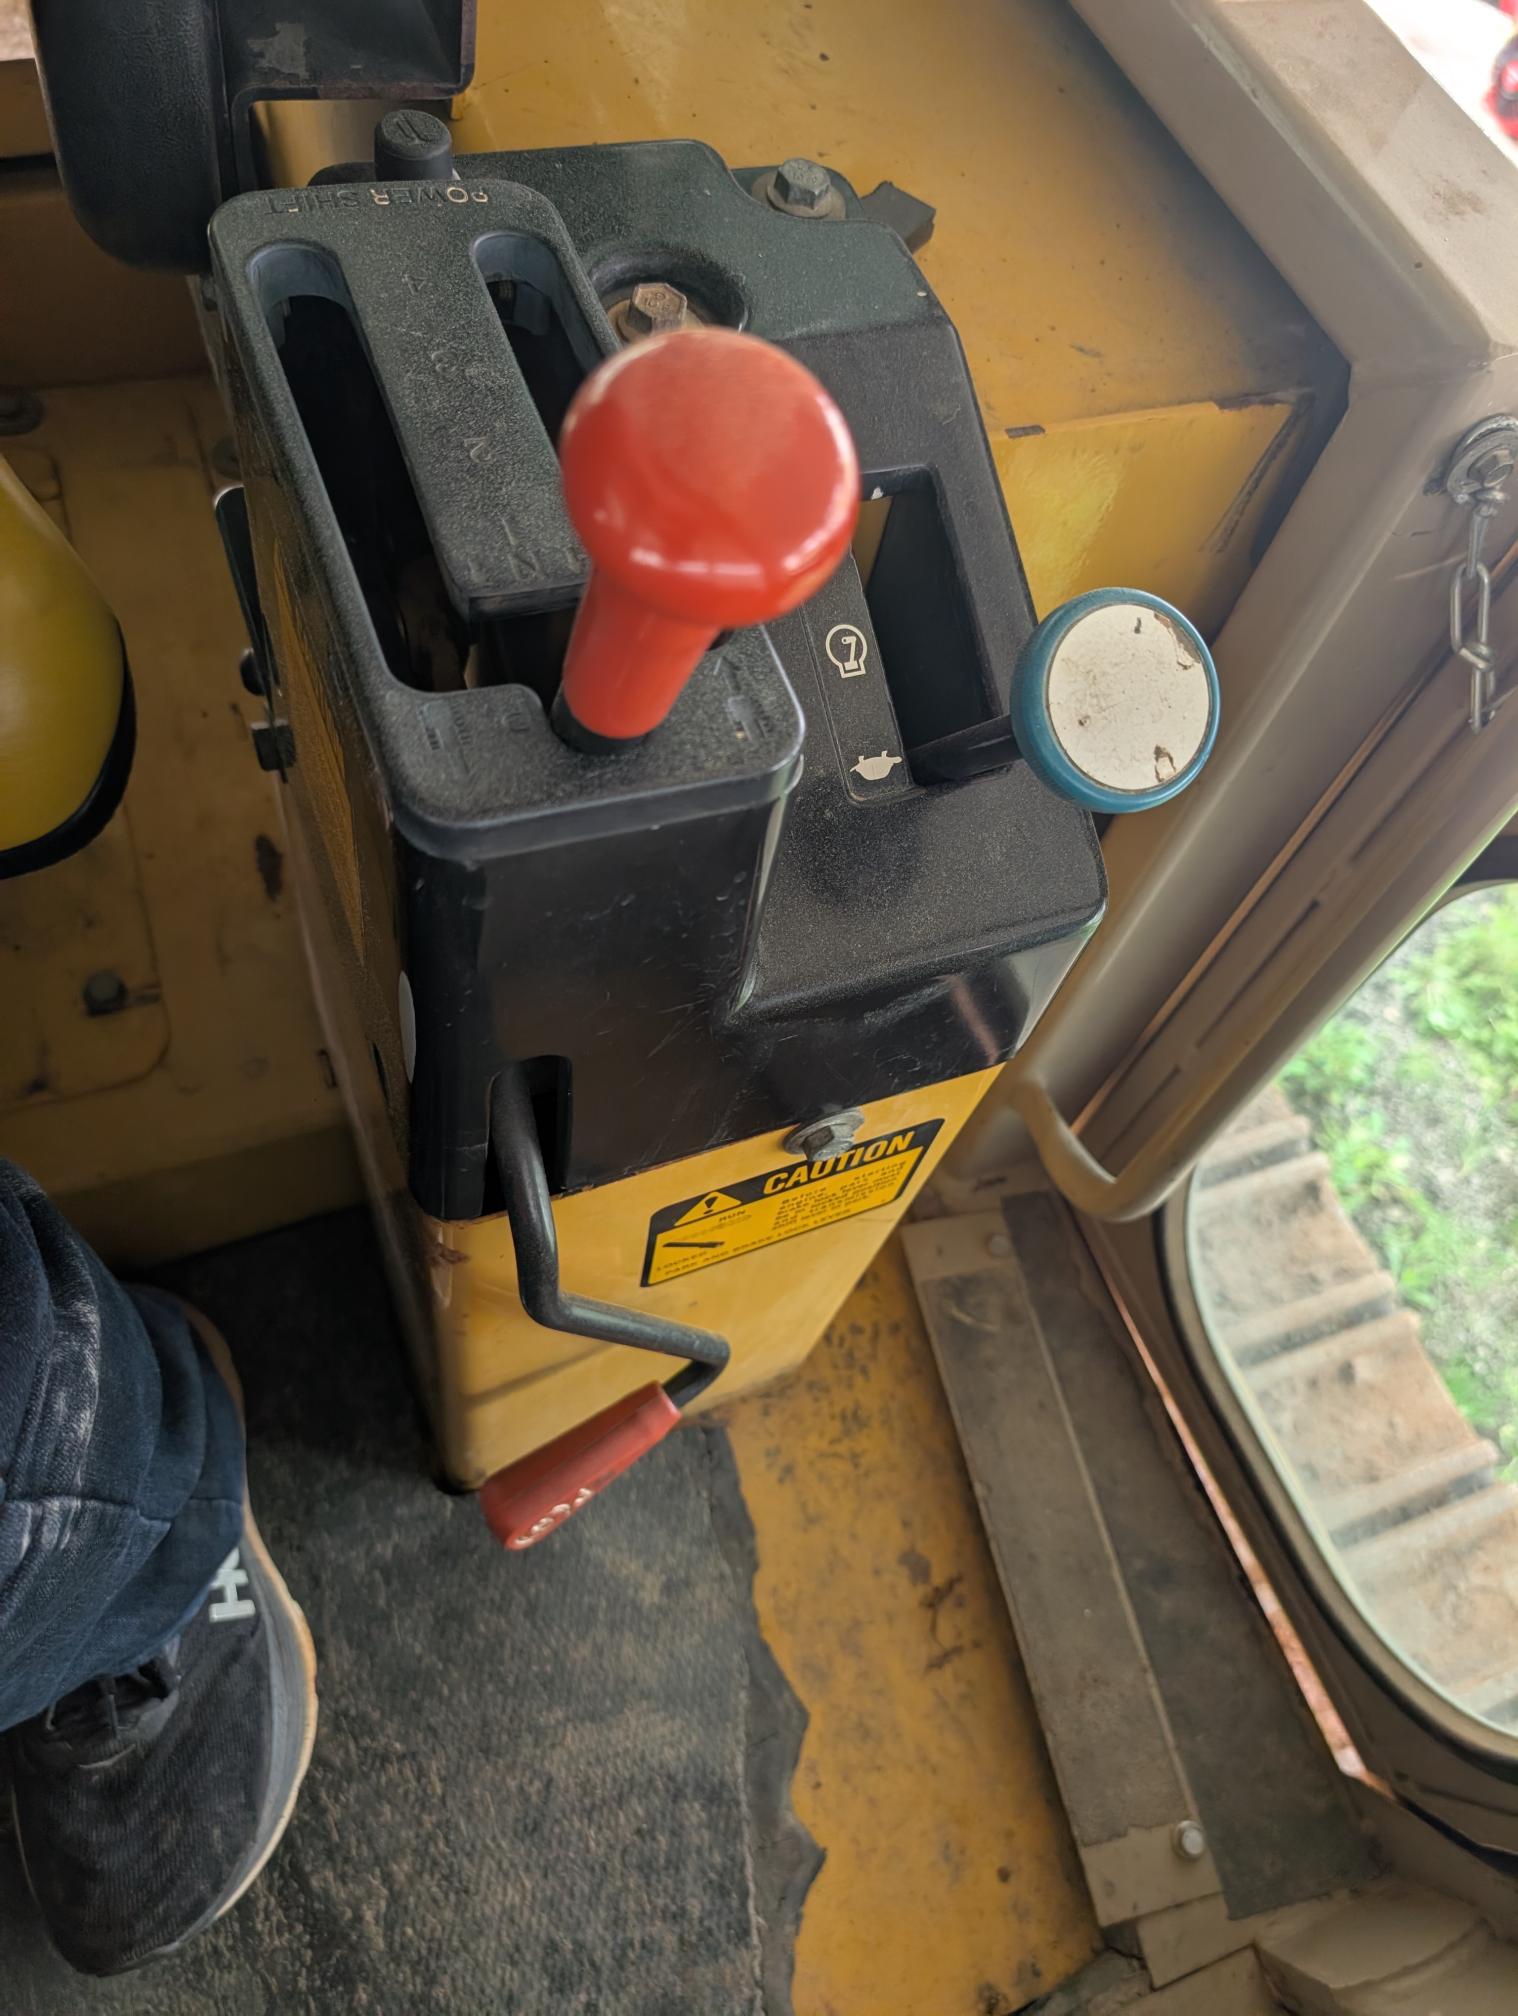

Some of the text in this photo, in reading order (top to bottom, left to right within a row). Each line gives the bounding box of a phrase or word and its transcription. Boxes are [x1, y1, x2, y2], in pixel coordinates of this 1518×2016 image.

[264, 186, 489, 214] POWER SHIFT
[763, 1131, 913, 1195] CAUTION
[781, 1185, 827, 1205] Before
[718, 1208, 746, 1222] RUN
